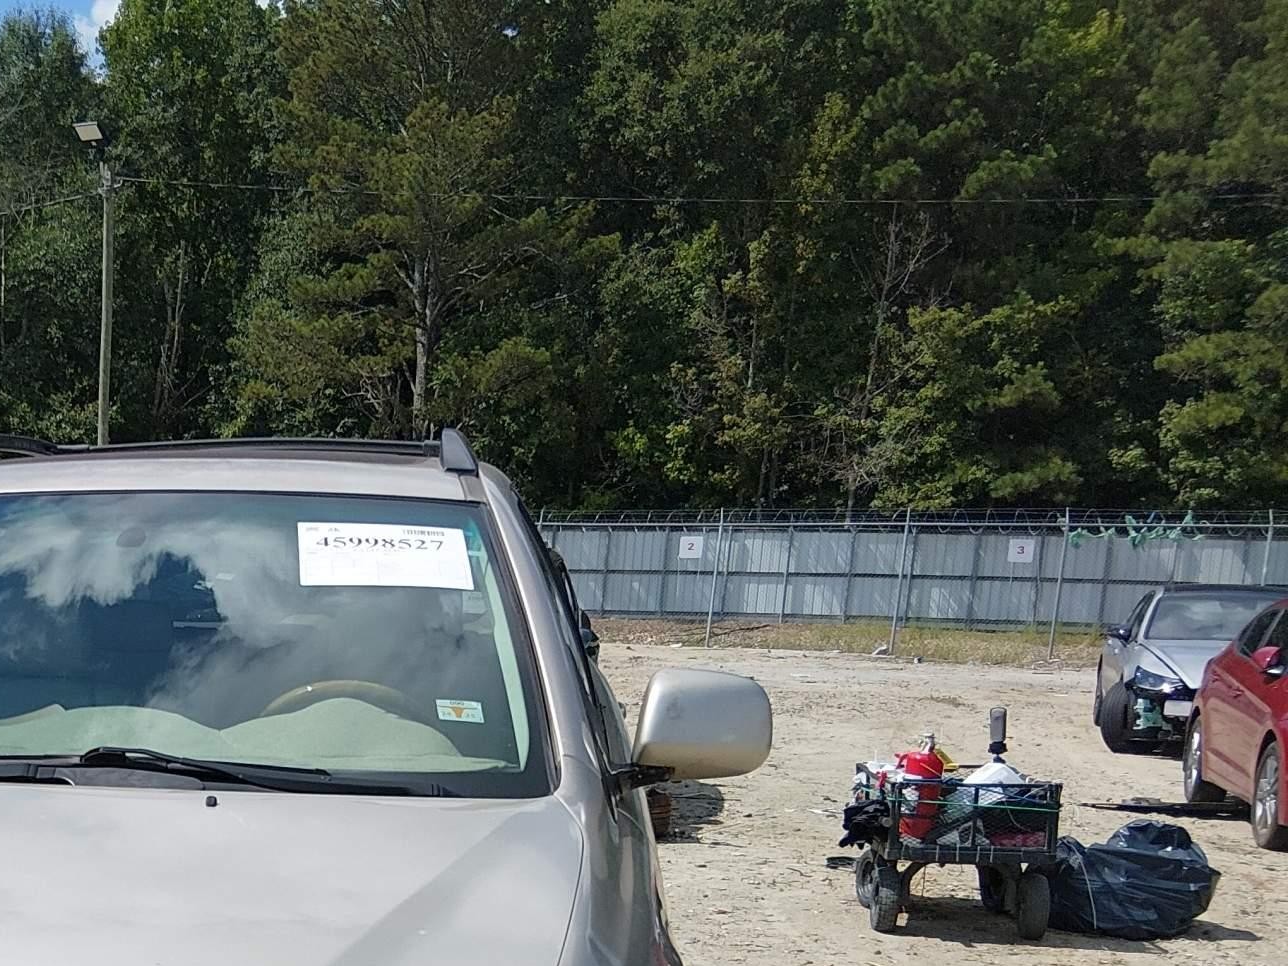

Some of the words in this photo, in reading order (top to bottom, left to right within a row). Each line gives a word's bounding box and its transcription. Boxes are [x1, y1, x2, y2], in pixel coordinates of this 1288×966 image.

[316, 537, 444, 551] 45998527
[687, 542, 695, 551] 2
[1016, 545, 1025, 555] 3
